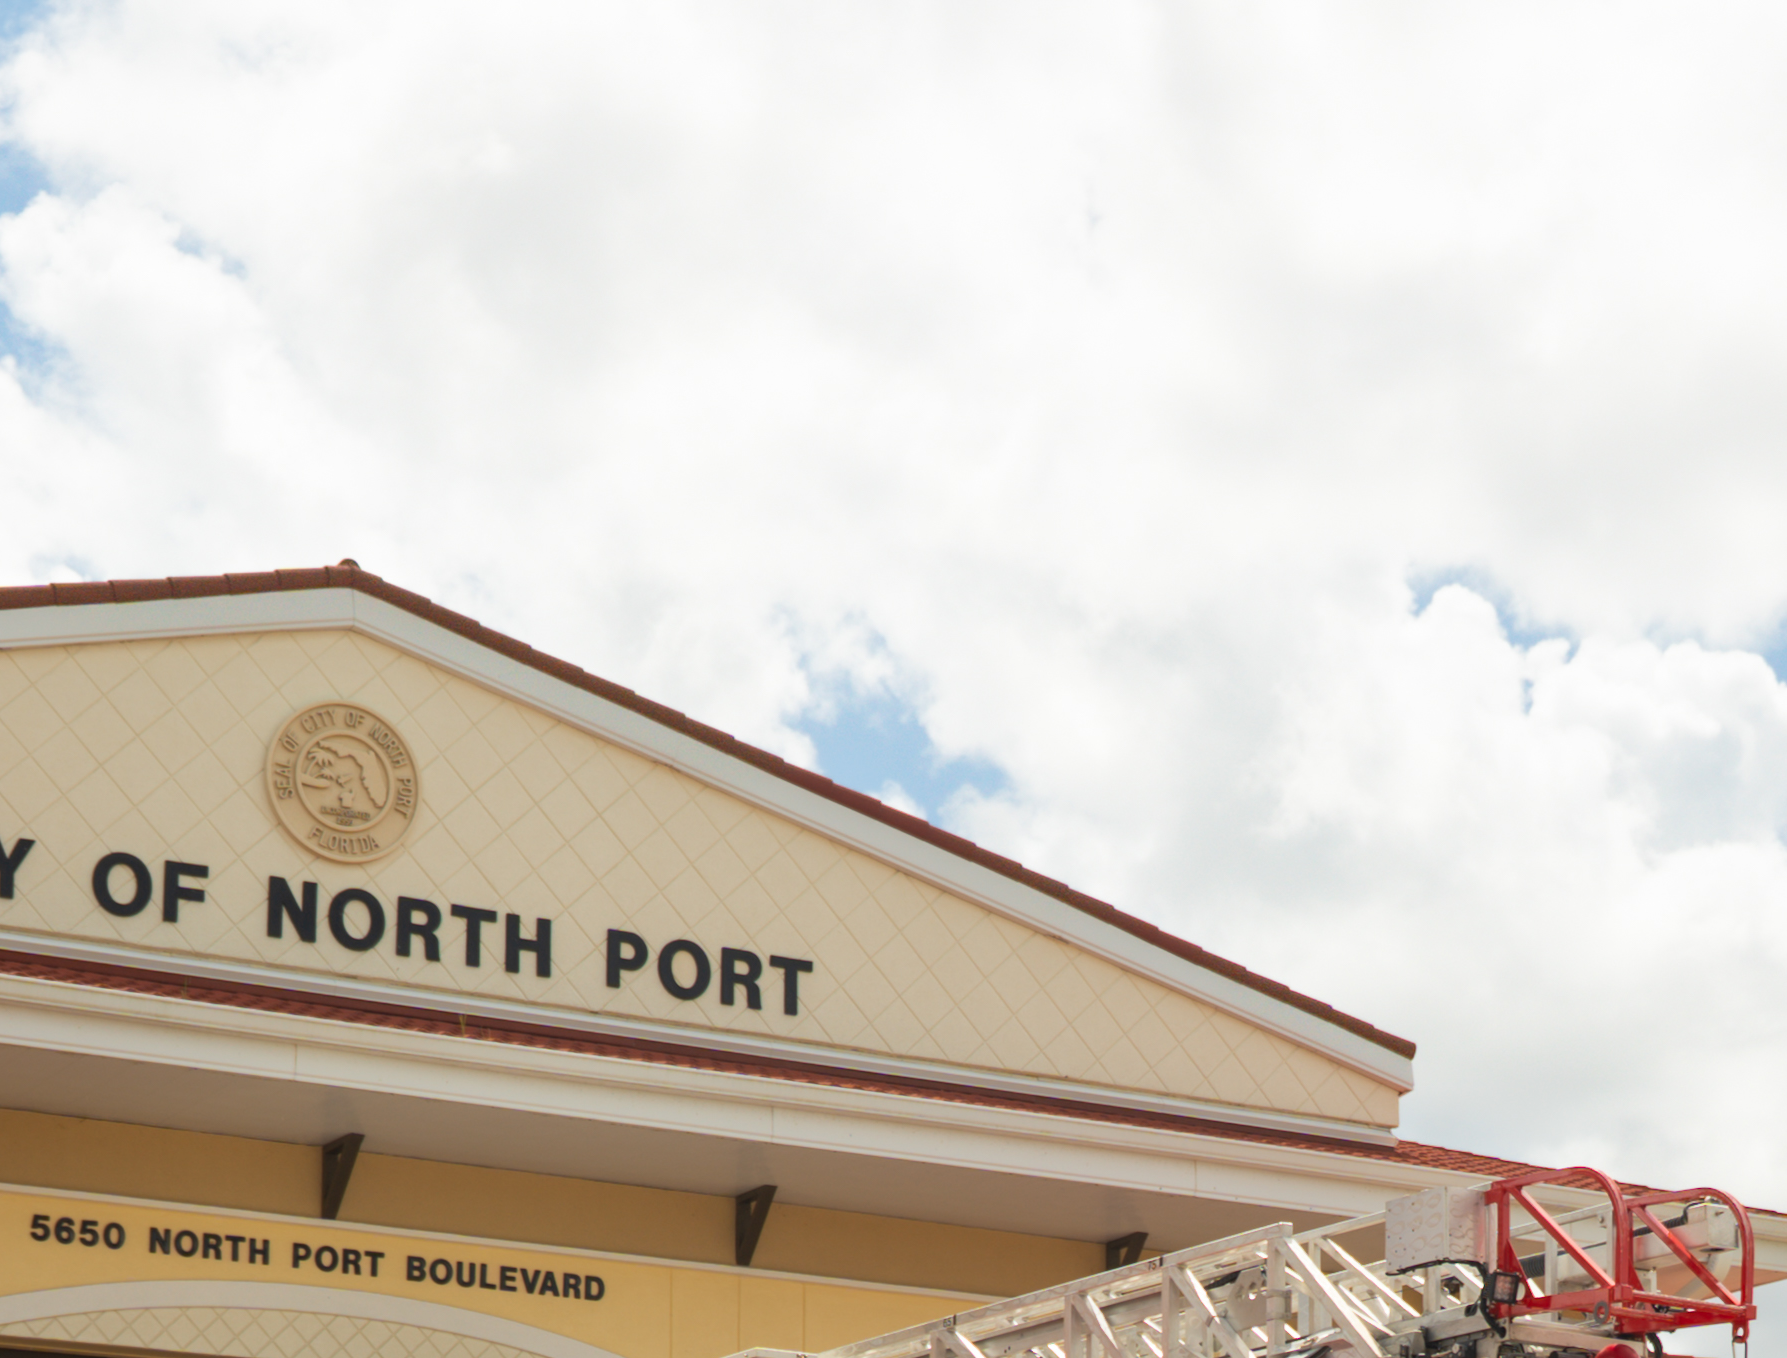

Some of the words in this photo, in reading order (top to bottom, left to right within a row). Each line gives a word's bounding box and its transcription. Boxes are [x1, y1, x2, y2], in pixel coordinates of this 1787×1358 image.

[301, 709, 336, 734] CITY
[344, 711, 366, 728] OF
[280, 730, 300, 752] OF
[368, 723, 407, 768] NORTH
[275, 760, 294, 799] SEAL
[394, 777, 414, 818] PORT
[309, 827, 380, 854] FLORIDA
[91, 851, 209, 924] OF
[266, 875, 552, 978] NORTH
[606, 928, 813, 1016] PORT
[30, 1213, 126, 1250] 5650
[148, 1226, 270, 1266] NORTH
[292, 1242, 385, 1278] PORT
[406, 1255, 605, 1302] BOULEVARD
